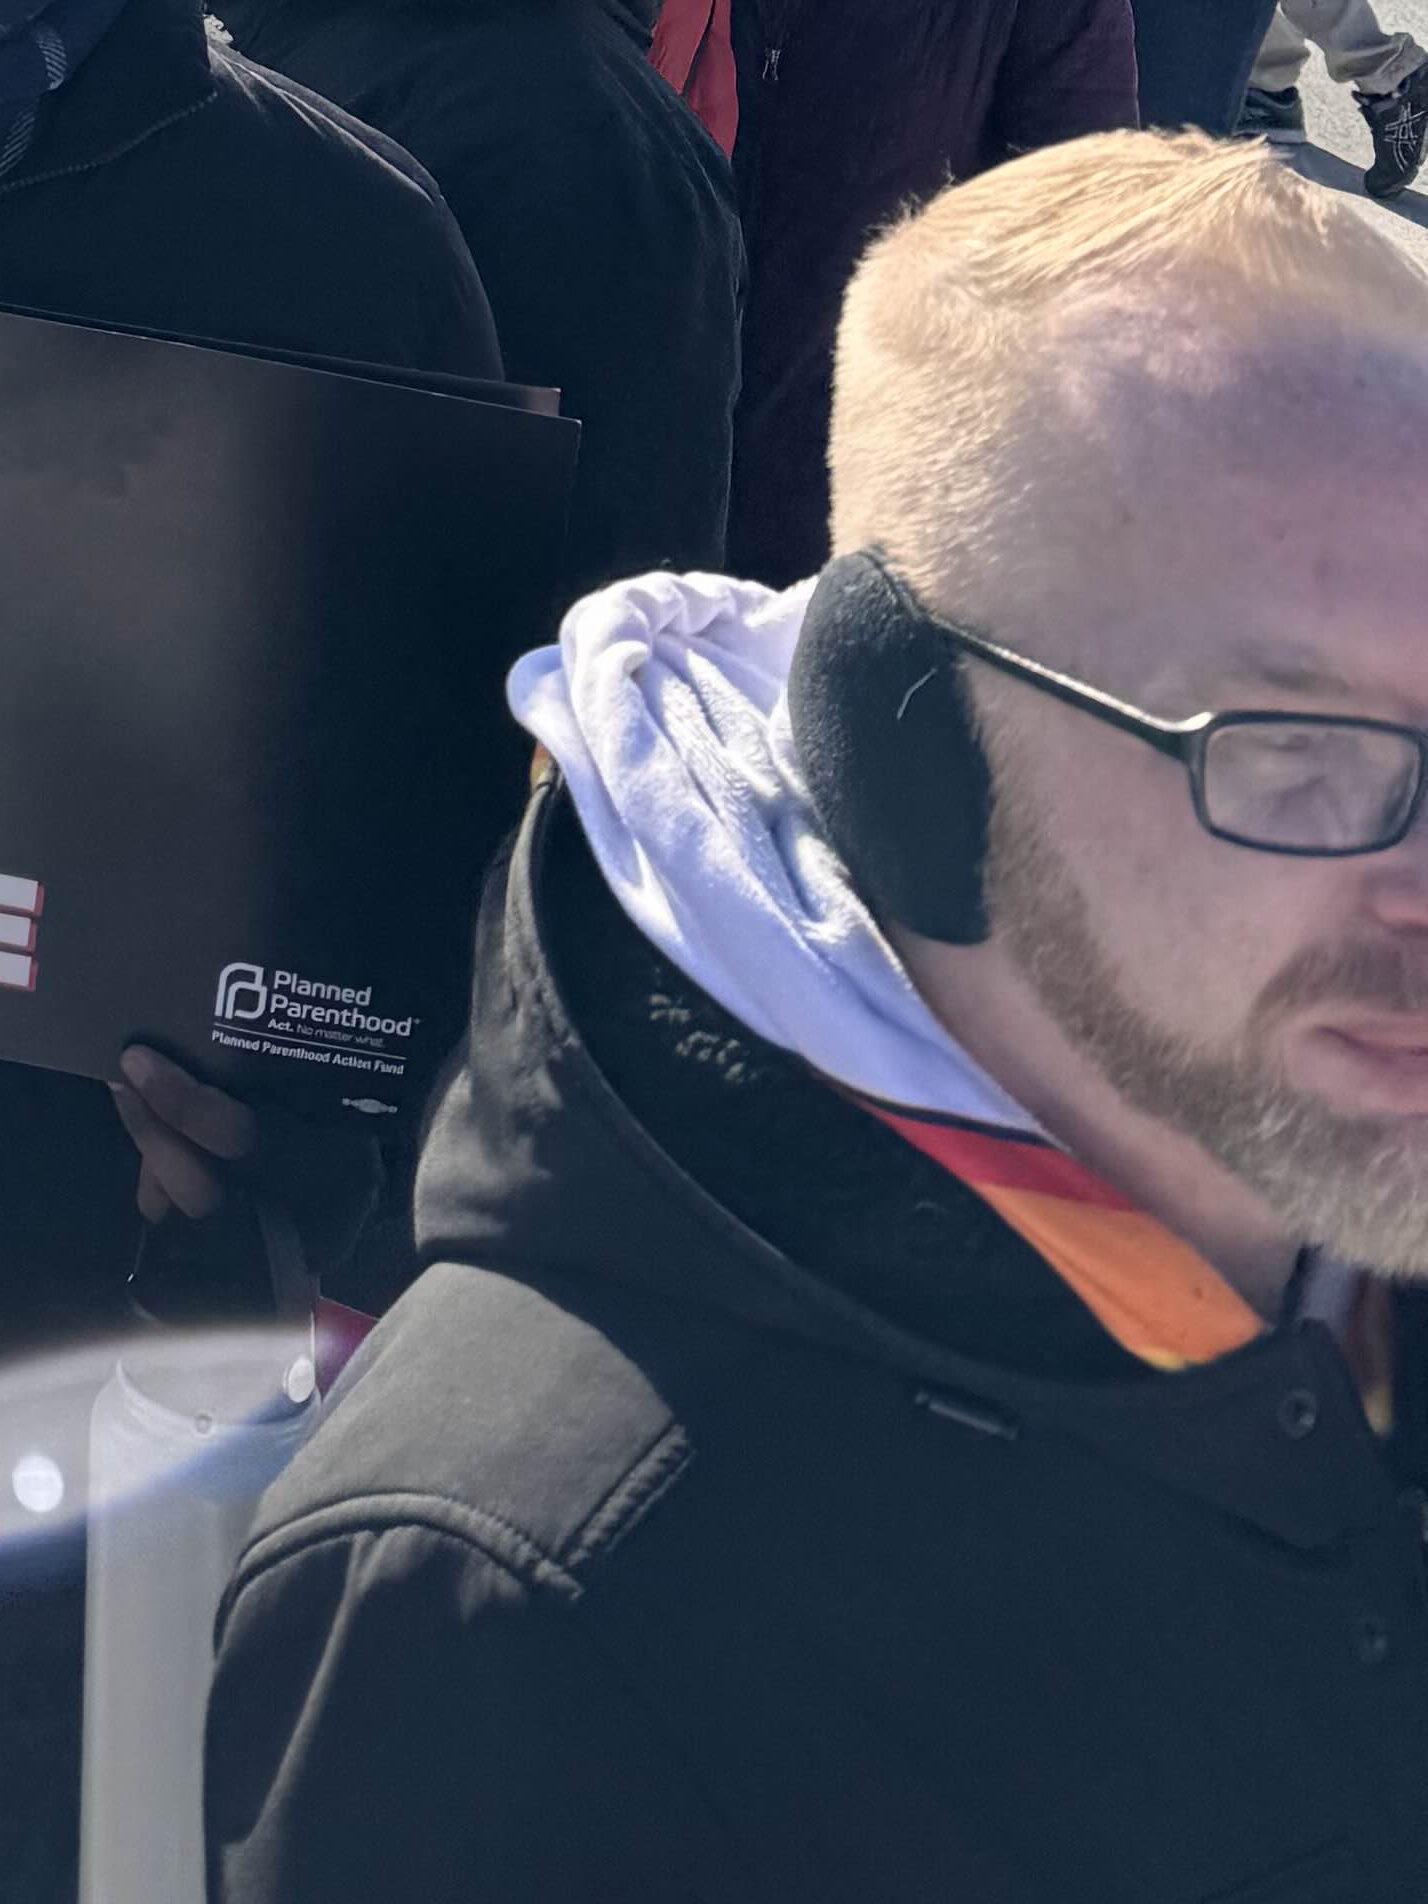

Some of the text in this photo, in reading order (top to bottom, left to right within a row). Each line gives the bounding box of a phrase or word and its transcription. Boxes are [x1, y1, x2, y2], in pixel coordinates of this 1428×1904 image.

[273, 970, 372, 1006] Planned
[267, 1018, 294, 1032] Act.
[296, 1024, 313, 1036] No
[315, 1029, 354, 1042] matter
[270, 994, 412, 1036] Parenthood
[211, 1030, 405, 1075] Planned Parenthood Action Fund
